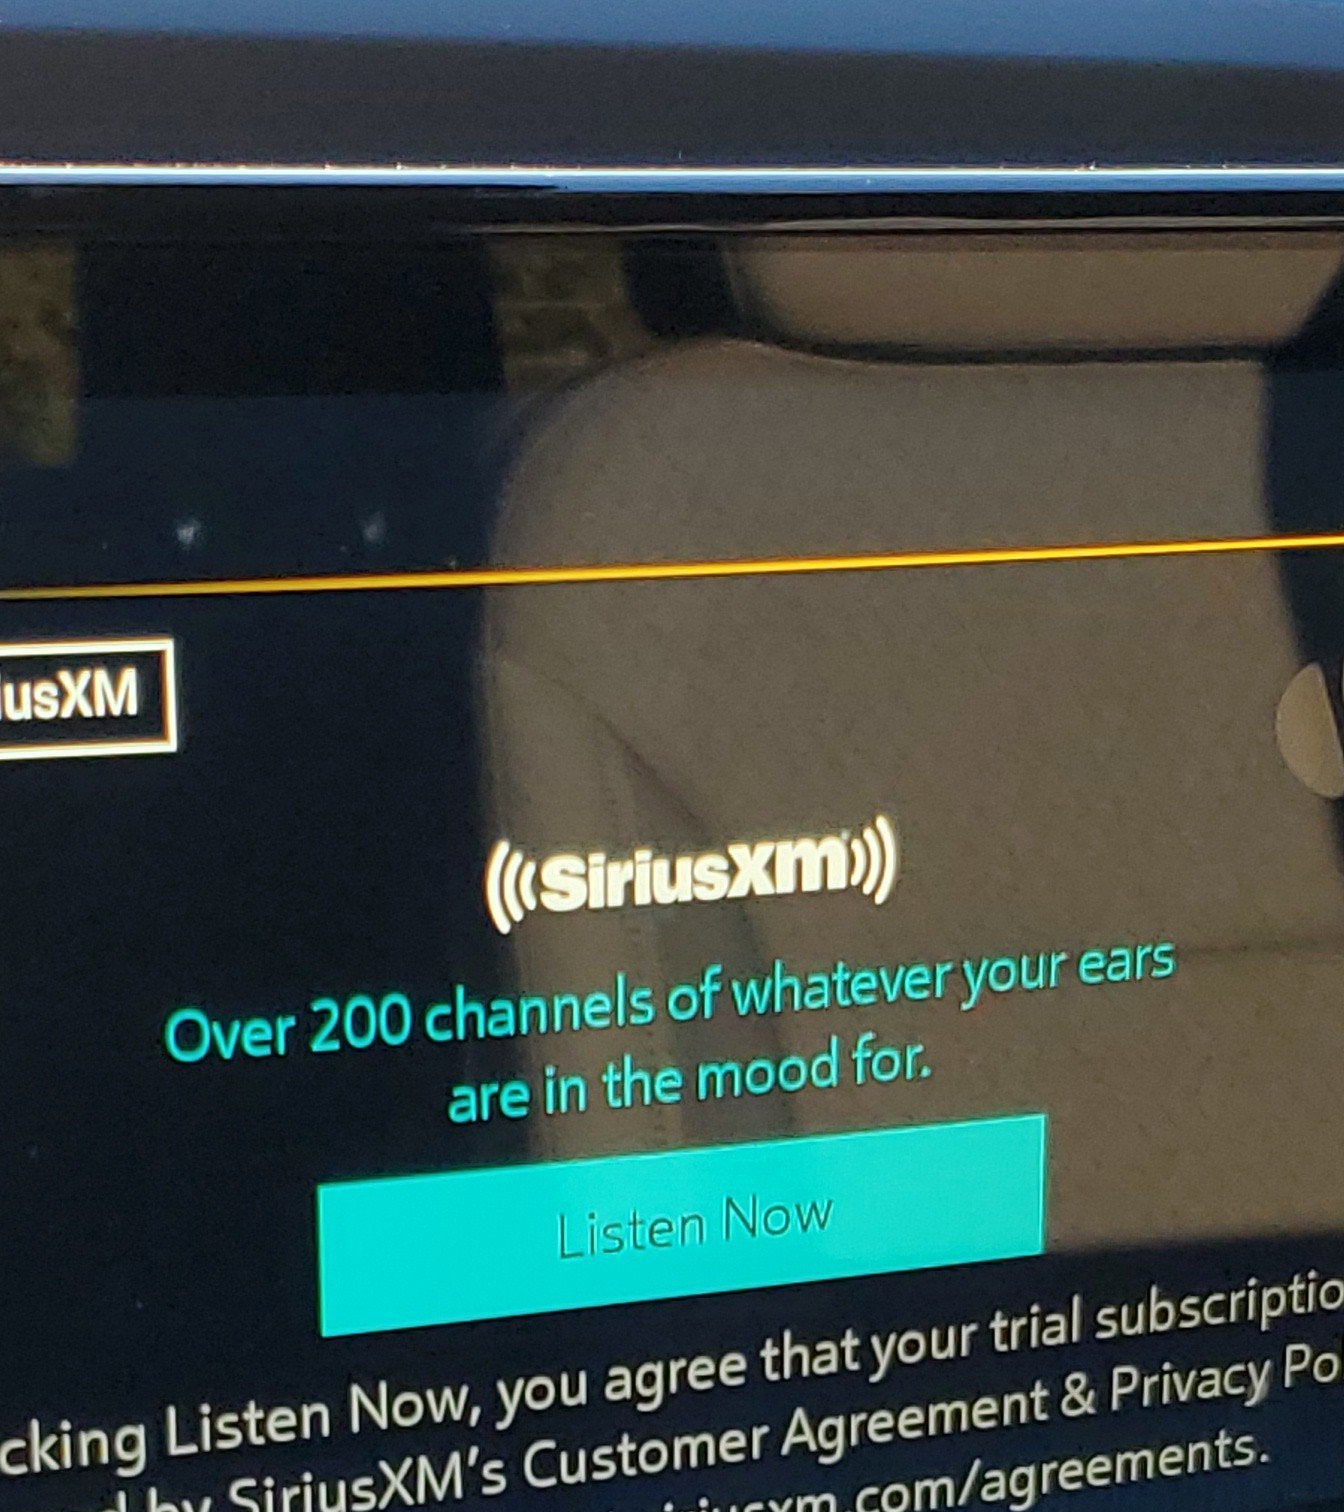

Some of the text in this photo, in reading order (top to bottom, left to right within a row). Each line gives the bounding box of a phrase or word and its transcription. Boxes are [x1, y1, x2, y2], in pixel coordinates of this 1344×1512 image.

[164, 940, 1175, 1063] Over 200 channels of whatever your ears
[447, 1030, 933, 1123] are in the mood for.
[558, 1192, 835, 1260] Listen Now
[164, 1399, 331, 1457] Listen
[349, 1380, 481, 1432] Now,
[496, 1371, 588, 1431] you
[603, 1350, 748, 1409] agree
[760, 1328, 860, 1384] that
[869, 1319, 978, 1382] your
[988, 1295, 1084, 1352] trial
[523, 1428, 770, 1490] Customer
[781, 1375, 1049, 1465] Agreement
[1060, 1369, 1097, 1416] &
[1111, 1356, 1271, 1412] Privacy
